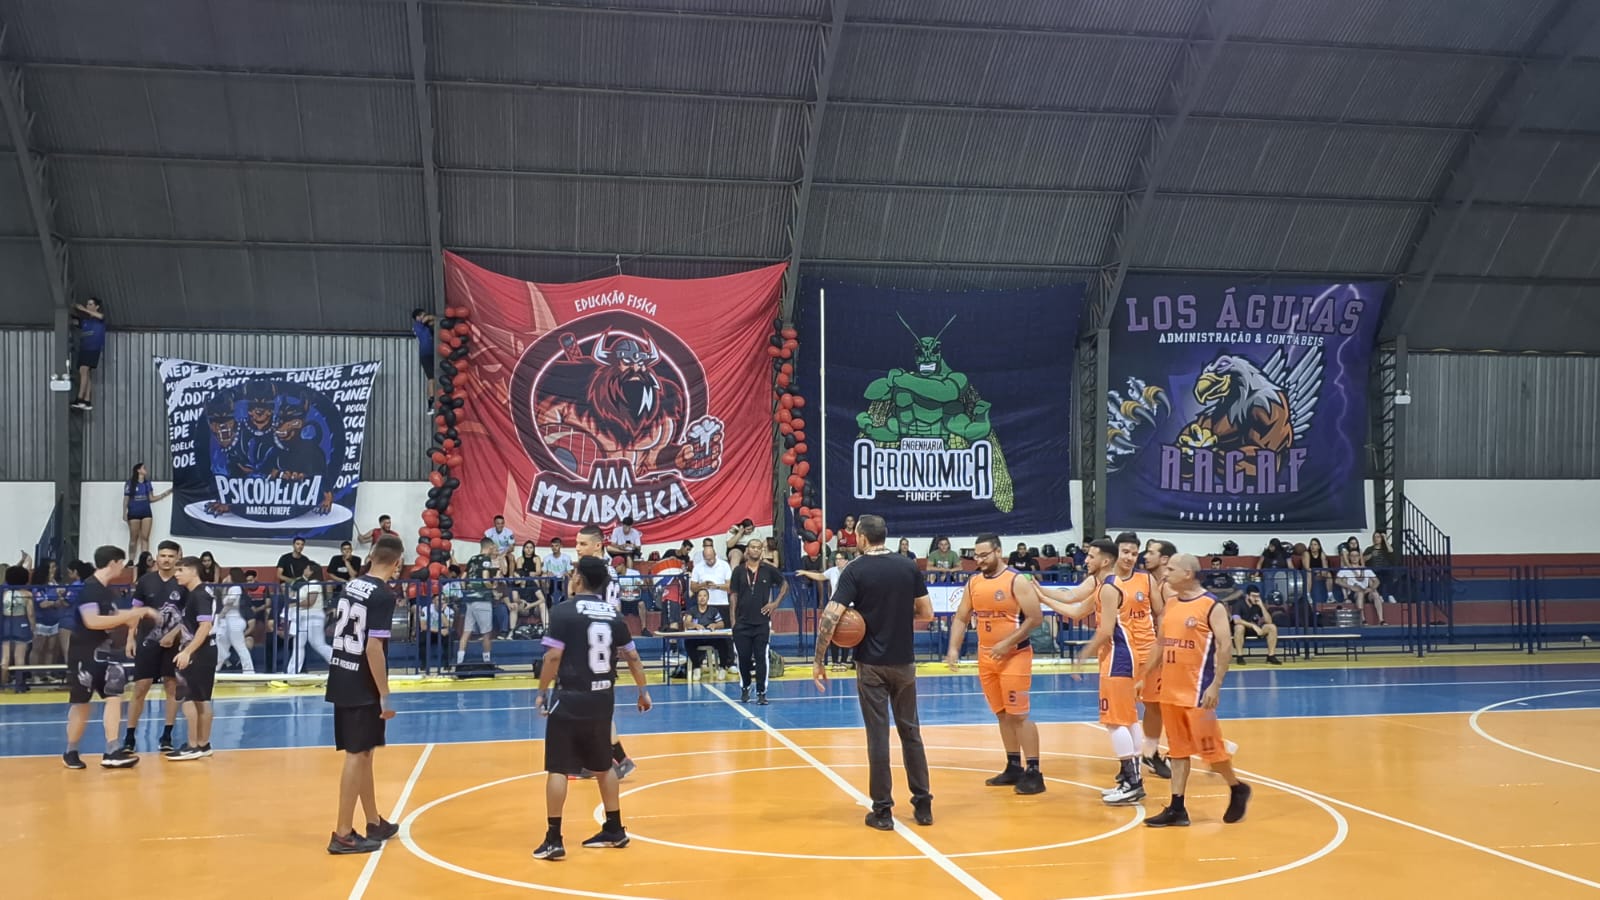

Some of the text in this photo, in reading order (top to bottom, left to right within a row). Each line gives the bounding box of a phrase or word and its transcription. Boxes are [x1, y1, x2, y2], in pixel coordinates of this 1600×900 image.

[574, 289, 625, 312] EDUCAÇÃO
[1126, 287, 1363, 334] LOS ÁGUIAS
[1158, 331, 1251, 344] ADMINISTRAÇÃO
[1255, 333, 1262, 343] &
[286, 366, 344, 383] FUNEPE
[902, 440, 943, 451] ENGENHARIA
[857, 442, 990, 497] AGRONOMICA
[905, 491, 942, 502] FUNEPE
[333, 597, 368, 655] 23
[588, 621, 612, 674] 8
[1167, 650, 1175, 664] 11
